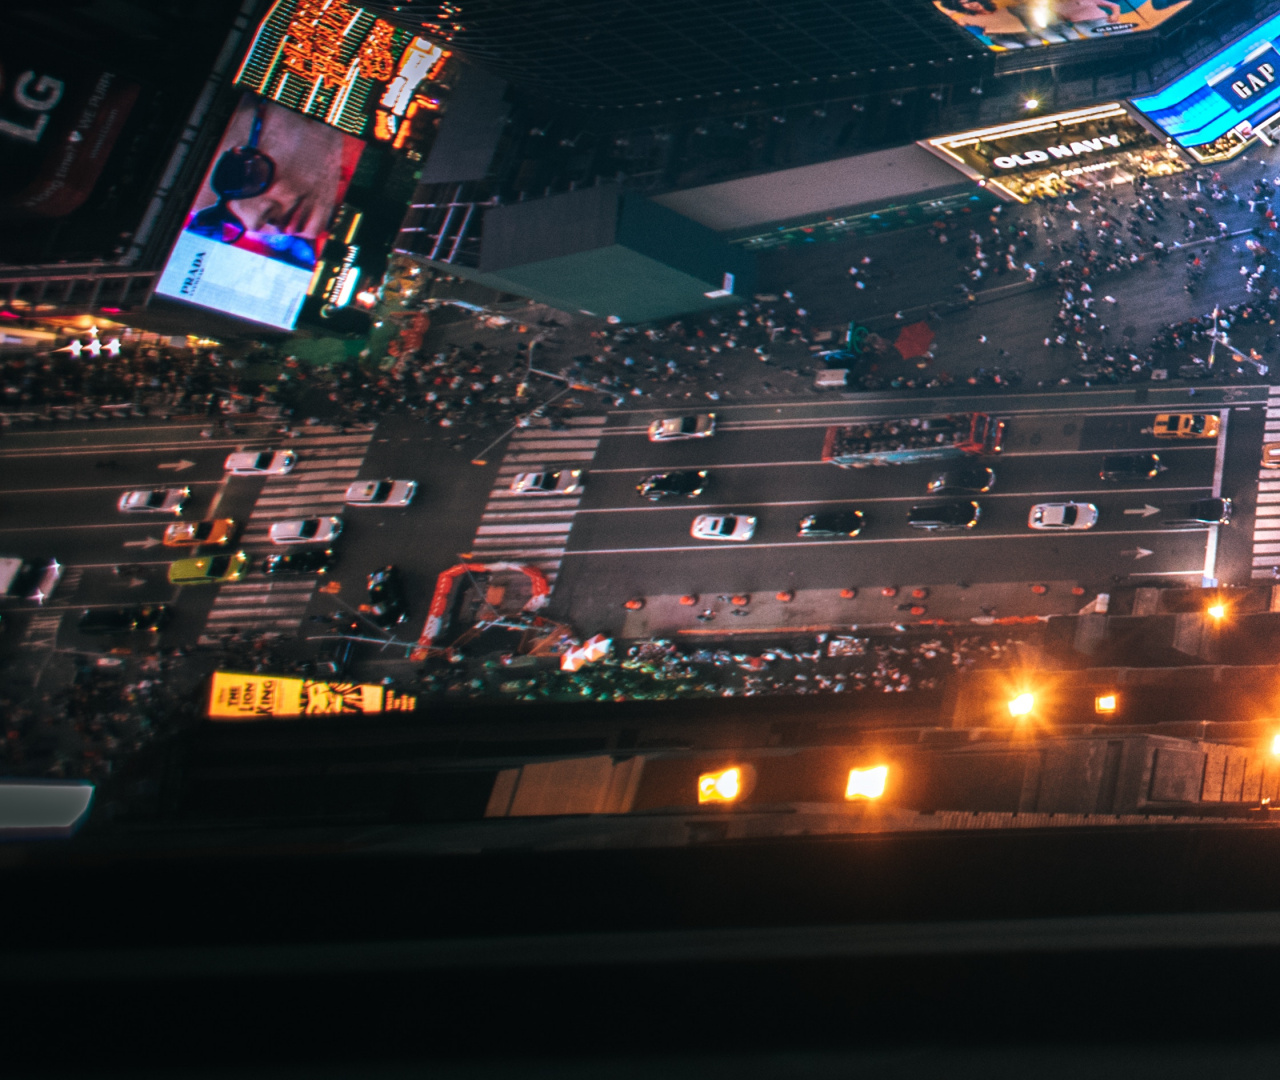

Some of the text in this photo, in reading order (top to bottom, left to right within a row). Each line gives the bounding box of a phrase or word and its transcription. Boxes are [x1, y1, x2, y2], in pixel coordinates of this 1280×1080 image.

[1231, 63, 1275, 99] GAP
[0, 70, 64, 142] LG
[993, 134, 1121, 168] OLD NAVY
[343, 245, 360, 262] hut
[180, 252, 206, 294] PRADA
[228, 686, 239, 706] THE
[239, 683, 256, 711] LION
[256, 680, 274, 715] KING
